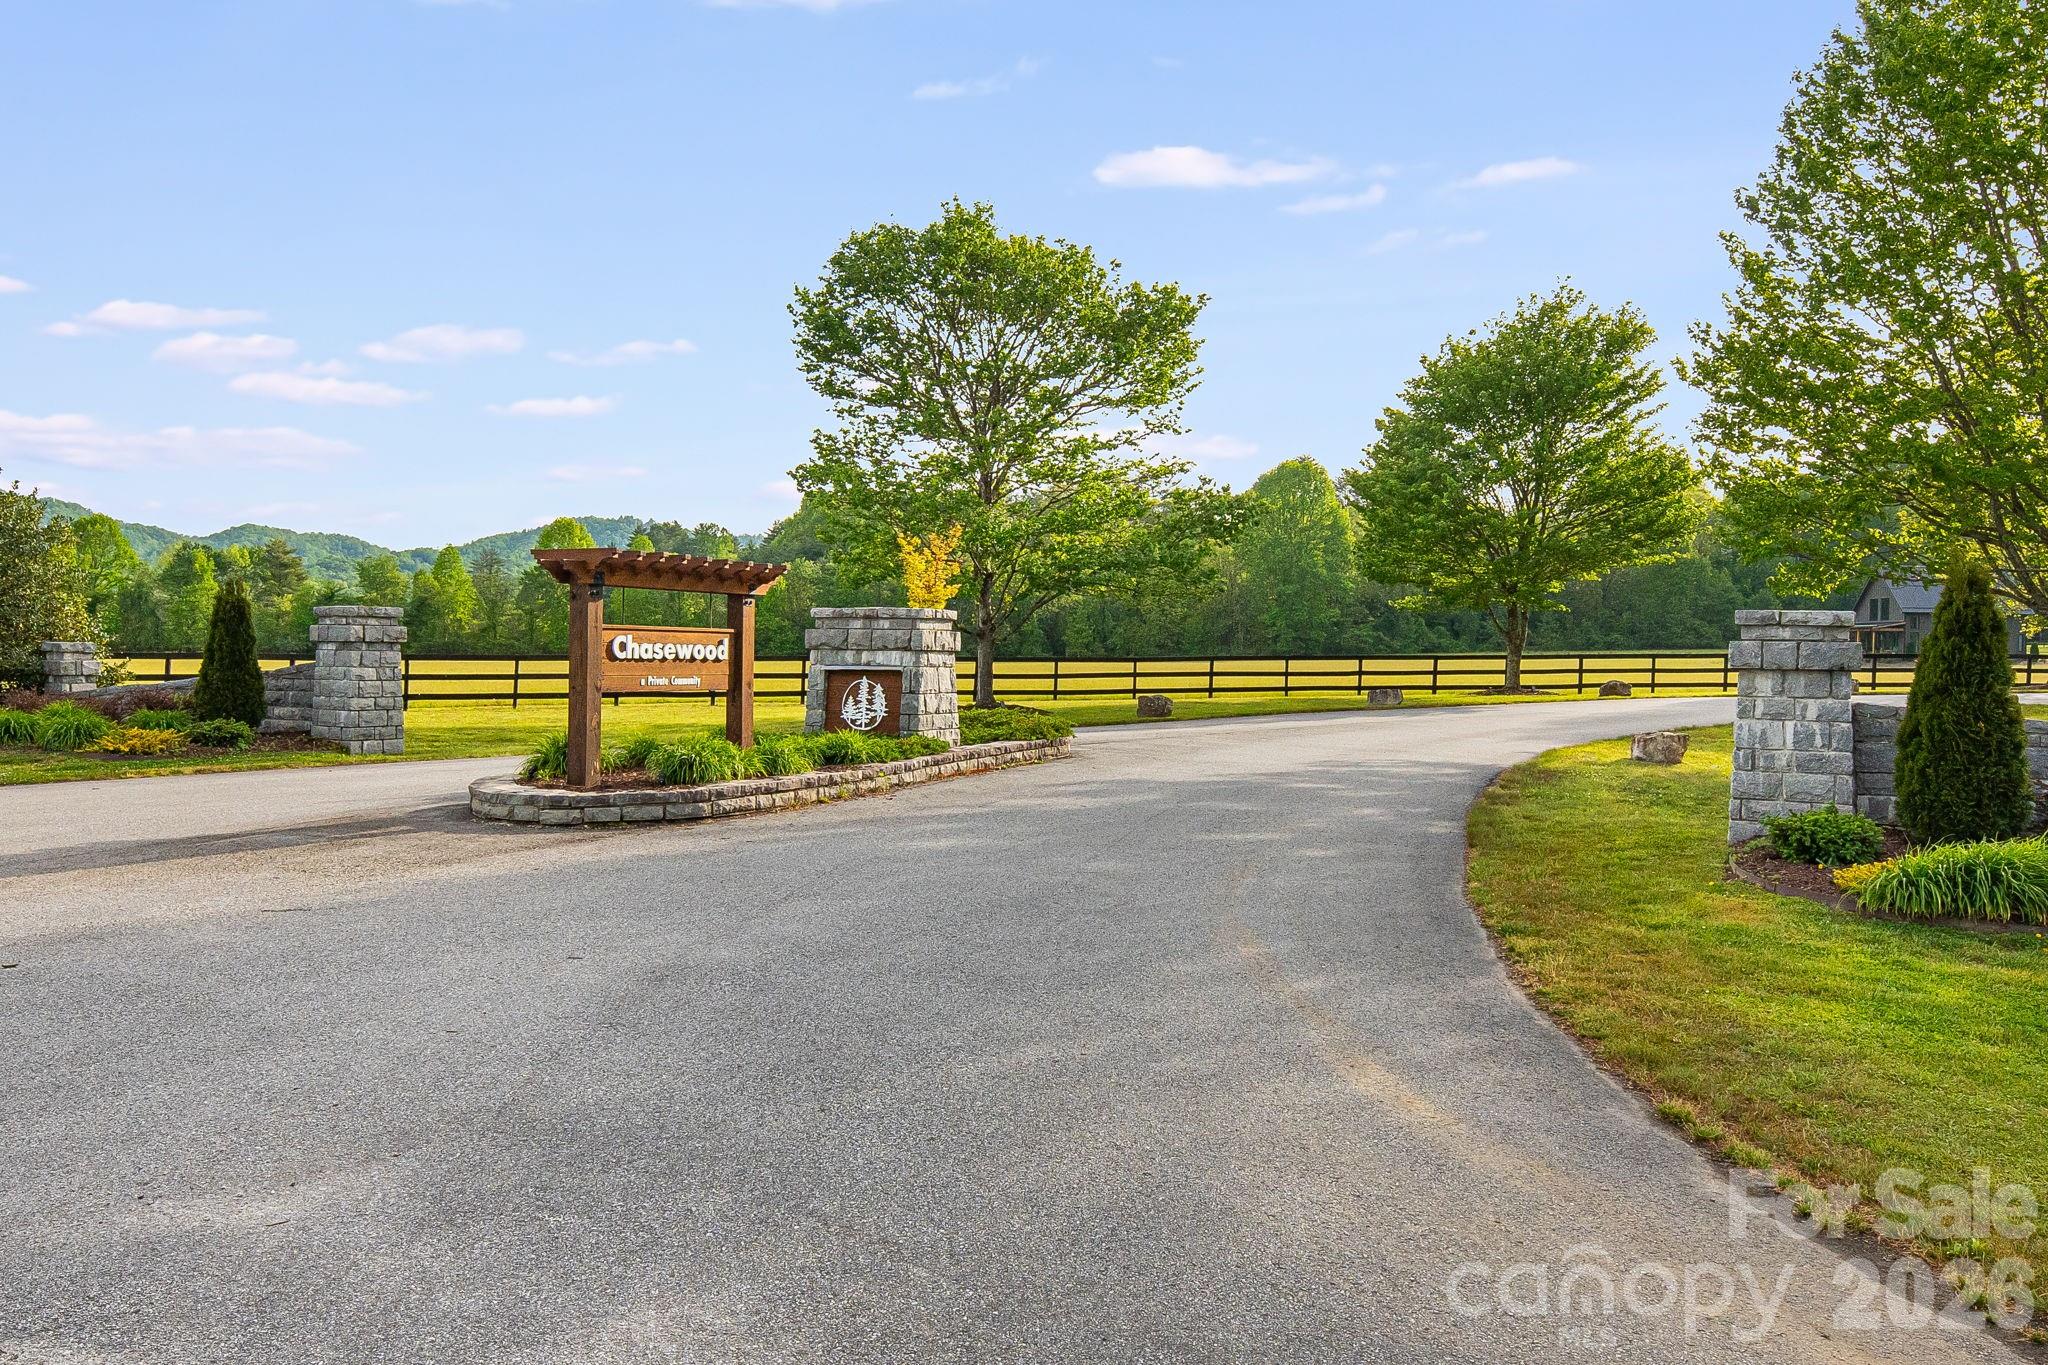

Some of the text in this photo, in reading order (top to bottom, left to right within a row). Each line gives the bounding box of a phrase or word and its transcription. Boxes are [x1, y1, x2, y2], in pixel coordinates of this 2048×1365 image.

[612, 634, 729, 661] Chasewood
[648, 676, 669, 686] Private
[671, 676, 702, 688] Community
